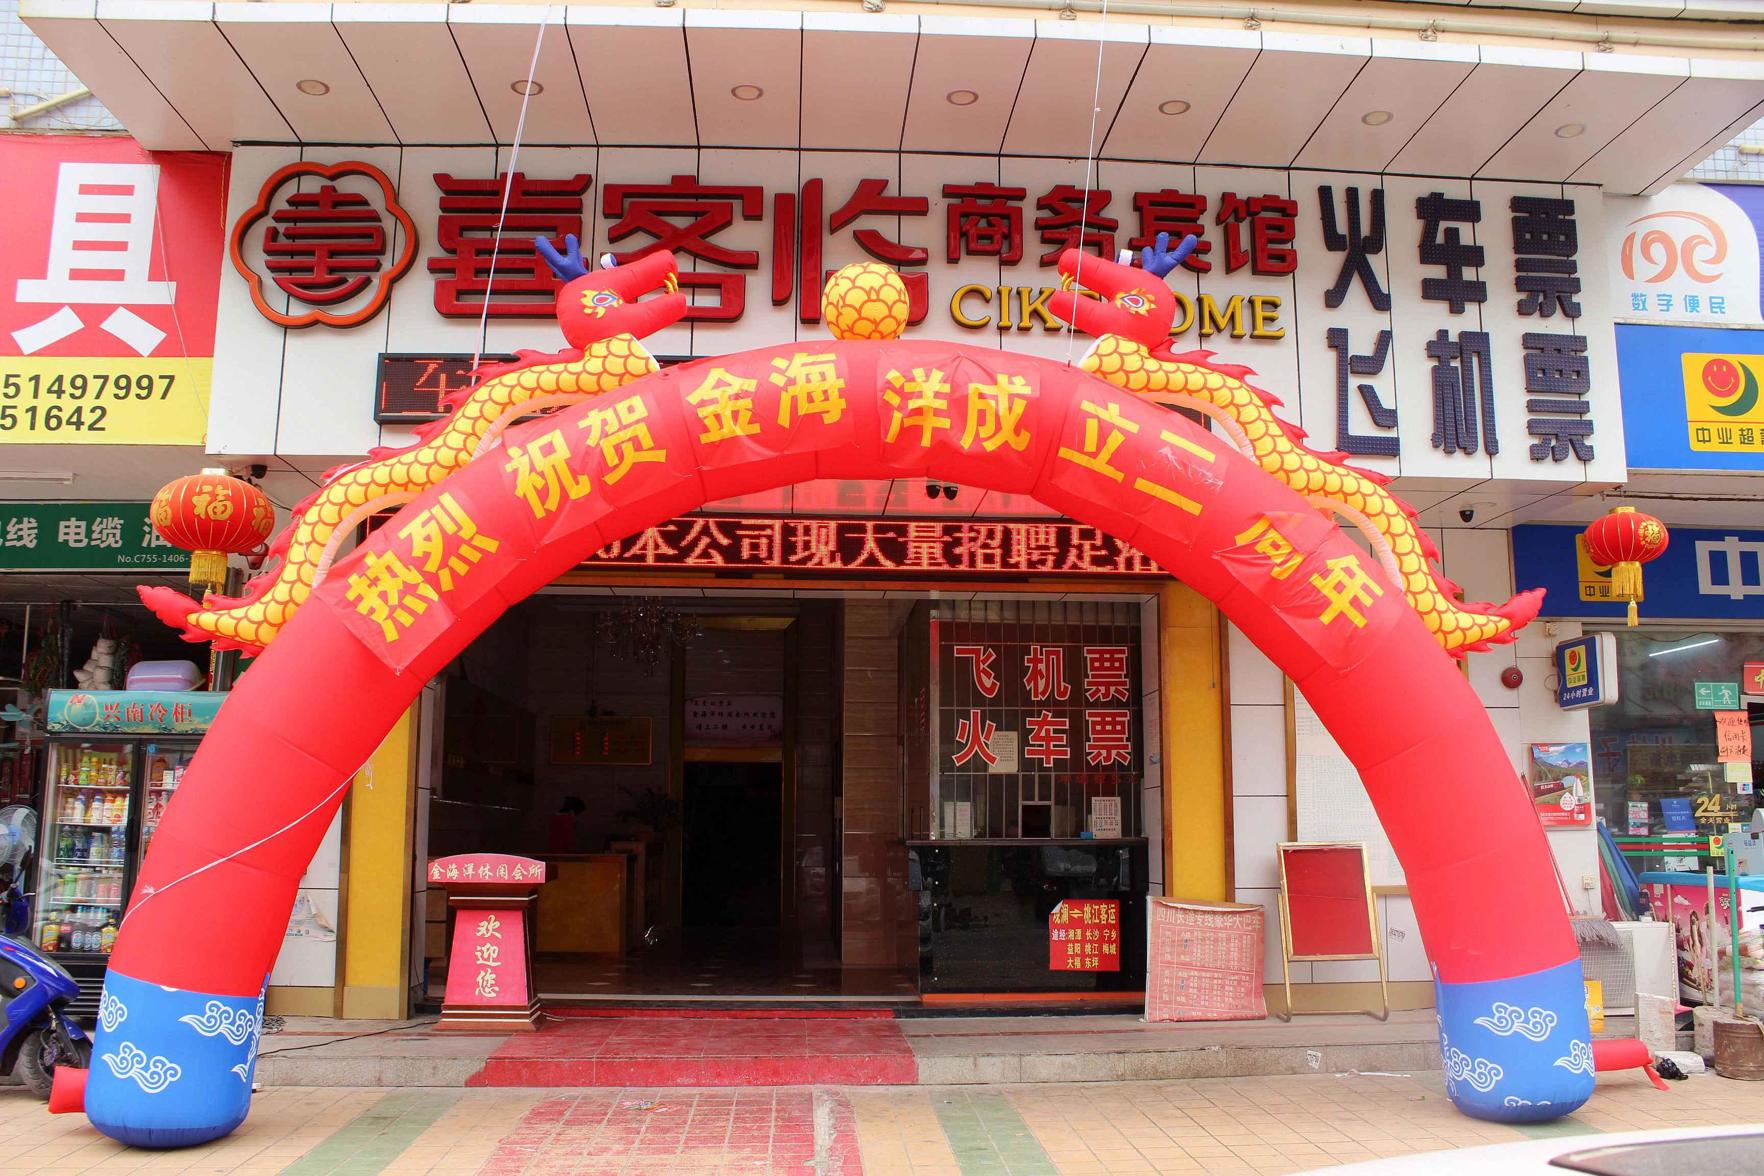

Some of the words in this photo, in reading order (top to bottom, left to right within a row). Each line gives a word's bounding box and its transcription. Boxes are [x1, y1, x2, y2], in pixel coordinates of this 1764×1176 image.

[941, 181, 1298, 276] 商务宾馆
[10, 161, 177, 357] 具
[1317, 185, 1582, 318] 火车票
[1631, 292, 1727, 314] 数字便民
[2, 373, 176, 400] 51497997
[1327, 326, 1595, 462] 飞机票
[0, 405, 107, 432] 51642
[191, 485, 234, 520] 福
[58, 517, 124, 548] 电缆
[1695, 536, 1764, 600] 中
[953, 645, 1130, 702] 飞机票
[103, 702, 192, 723] 兴南冷柜
[952, 710, 1132, 767] 火车票
[1695, 793, 1721, 817] 24
[430, 863, 543, 881] 金海洋休闲会所
[1084, 903, 1116, 925] 桃江客运
[1067, 943, 1081, 955] 益阳
[1085, 943, 1099, 955] 桃江
[1086, 929, 1100, 941] 长沙
[1103, 929, 1117, 941] 宁乡
[475, 914, 502, 998] 欢迎您
